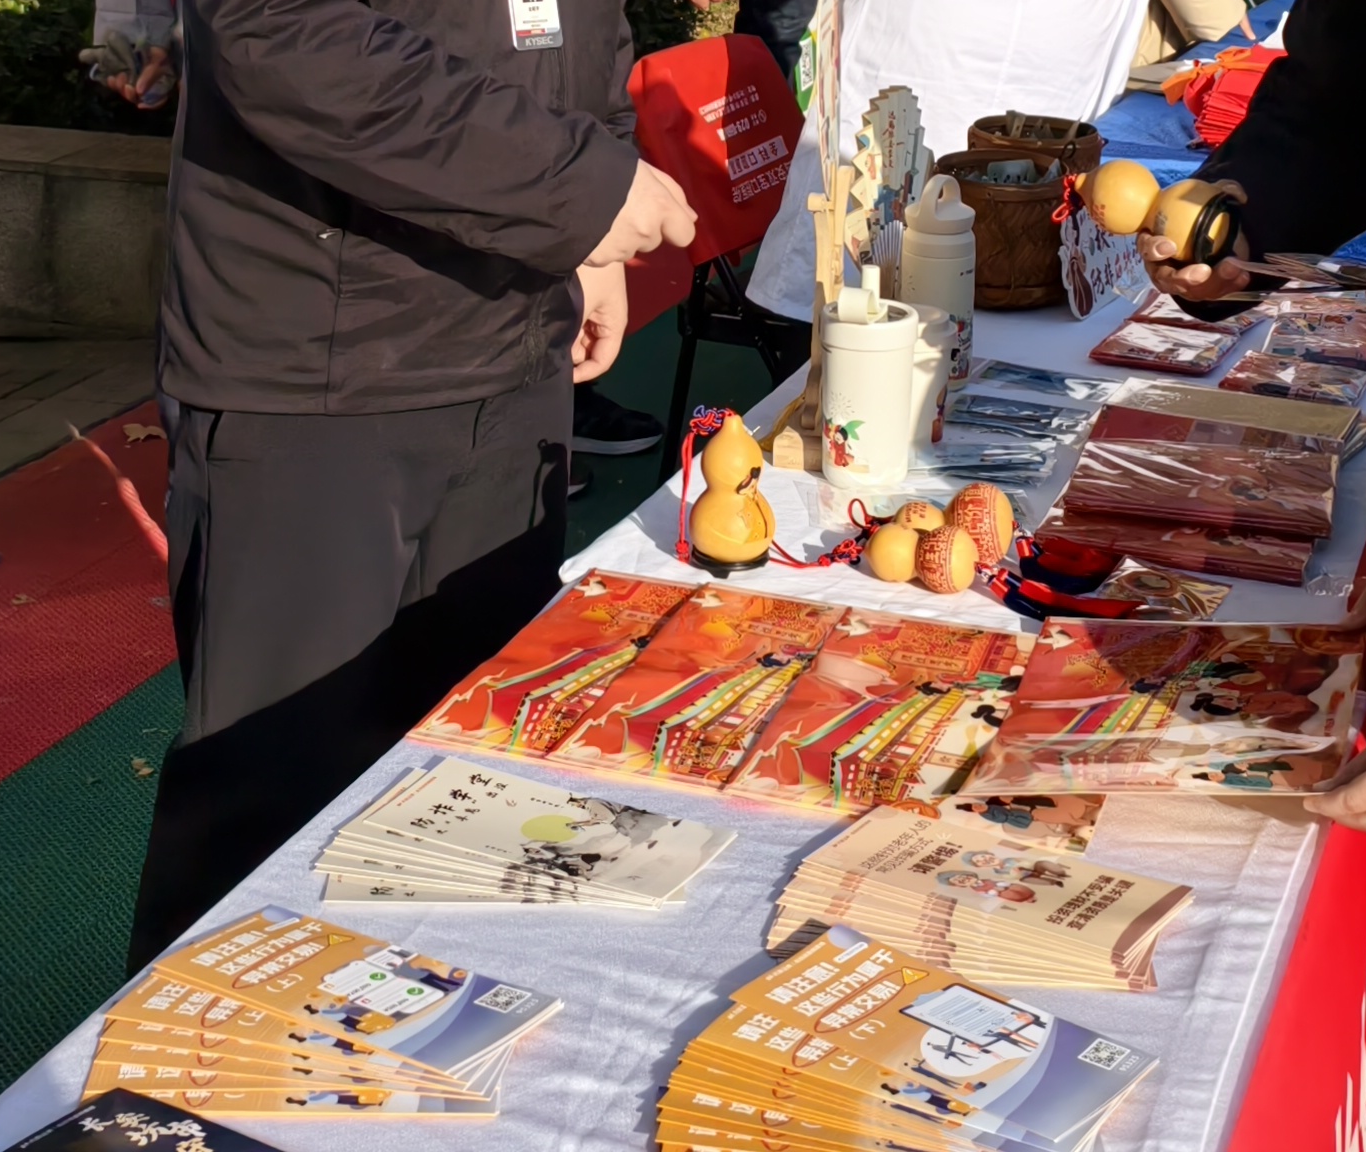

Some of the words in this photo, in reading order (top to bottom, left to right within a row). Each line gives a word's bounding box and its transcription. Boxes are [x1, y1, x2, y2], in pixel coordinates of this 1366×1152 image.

[525, 35, 554, 46] KYSEC
[765, 961, 841, 1005] 请注意！
[820, 980, 902, 1028] 异常交易！
